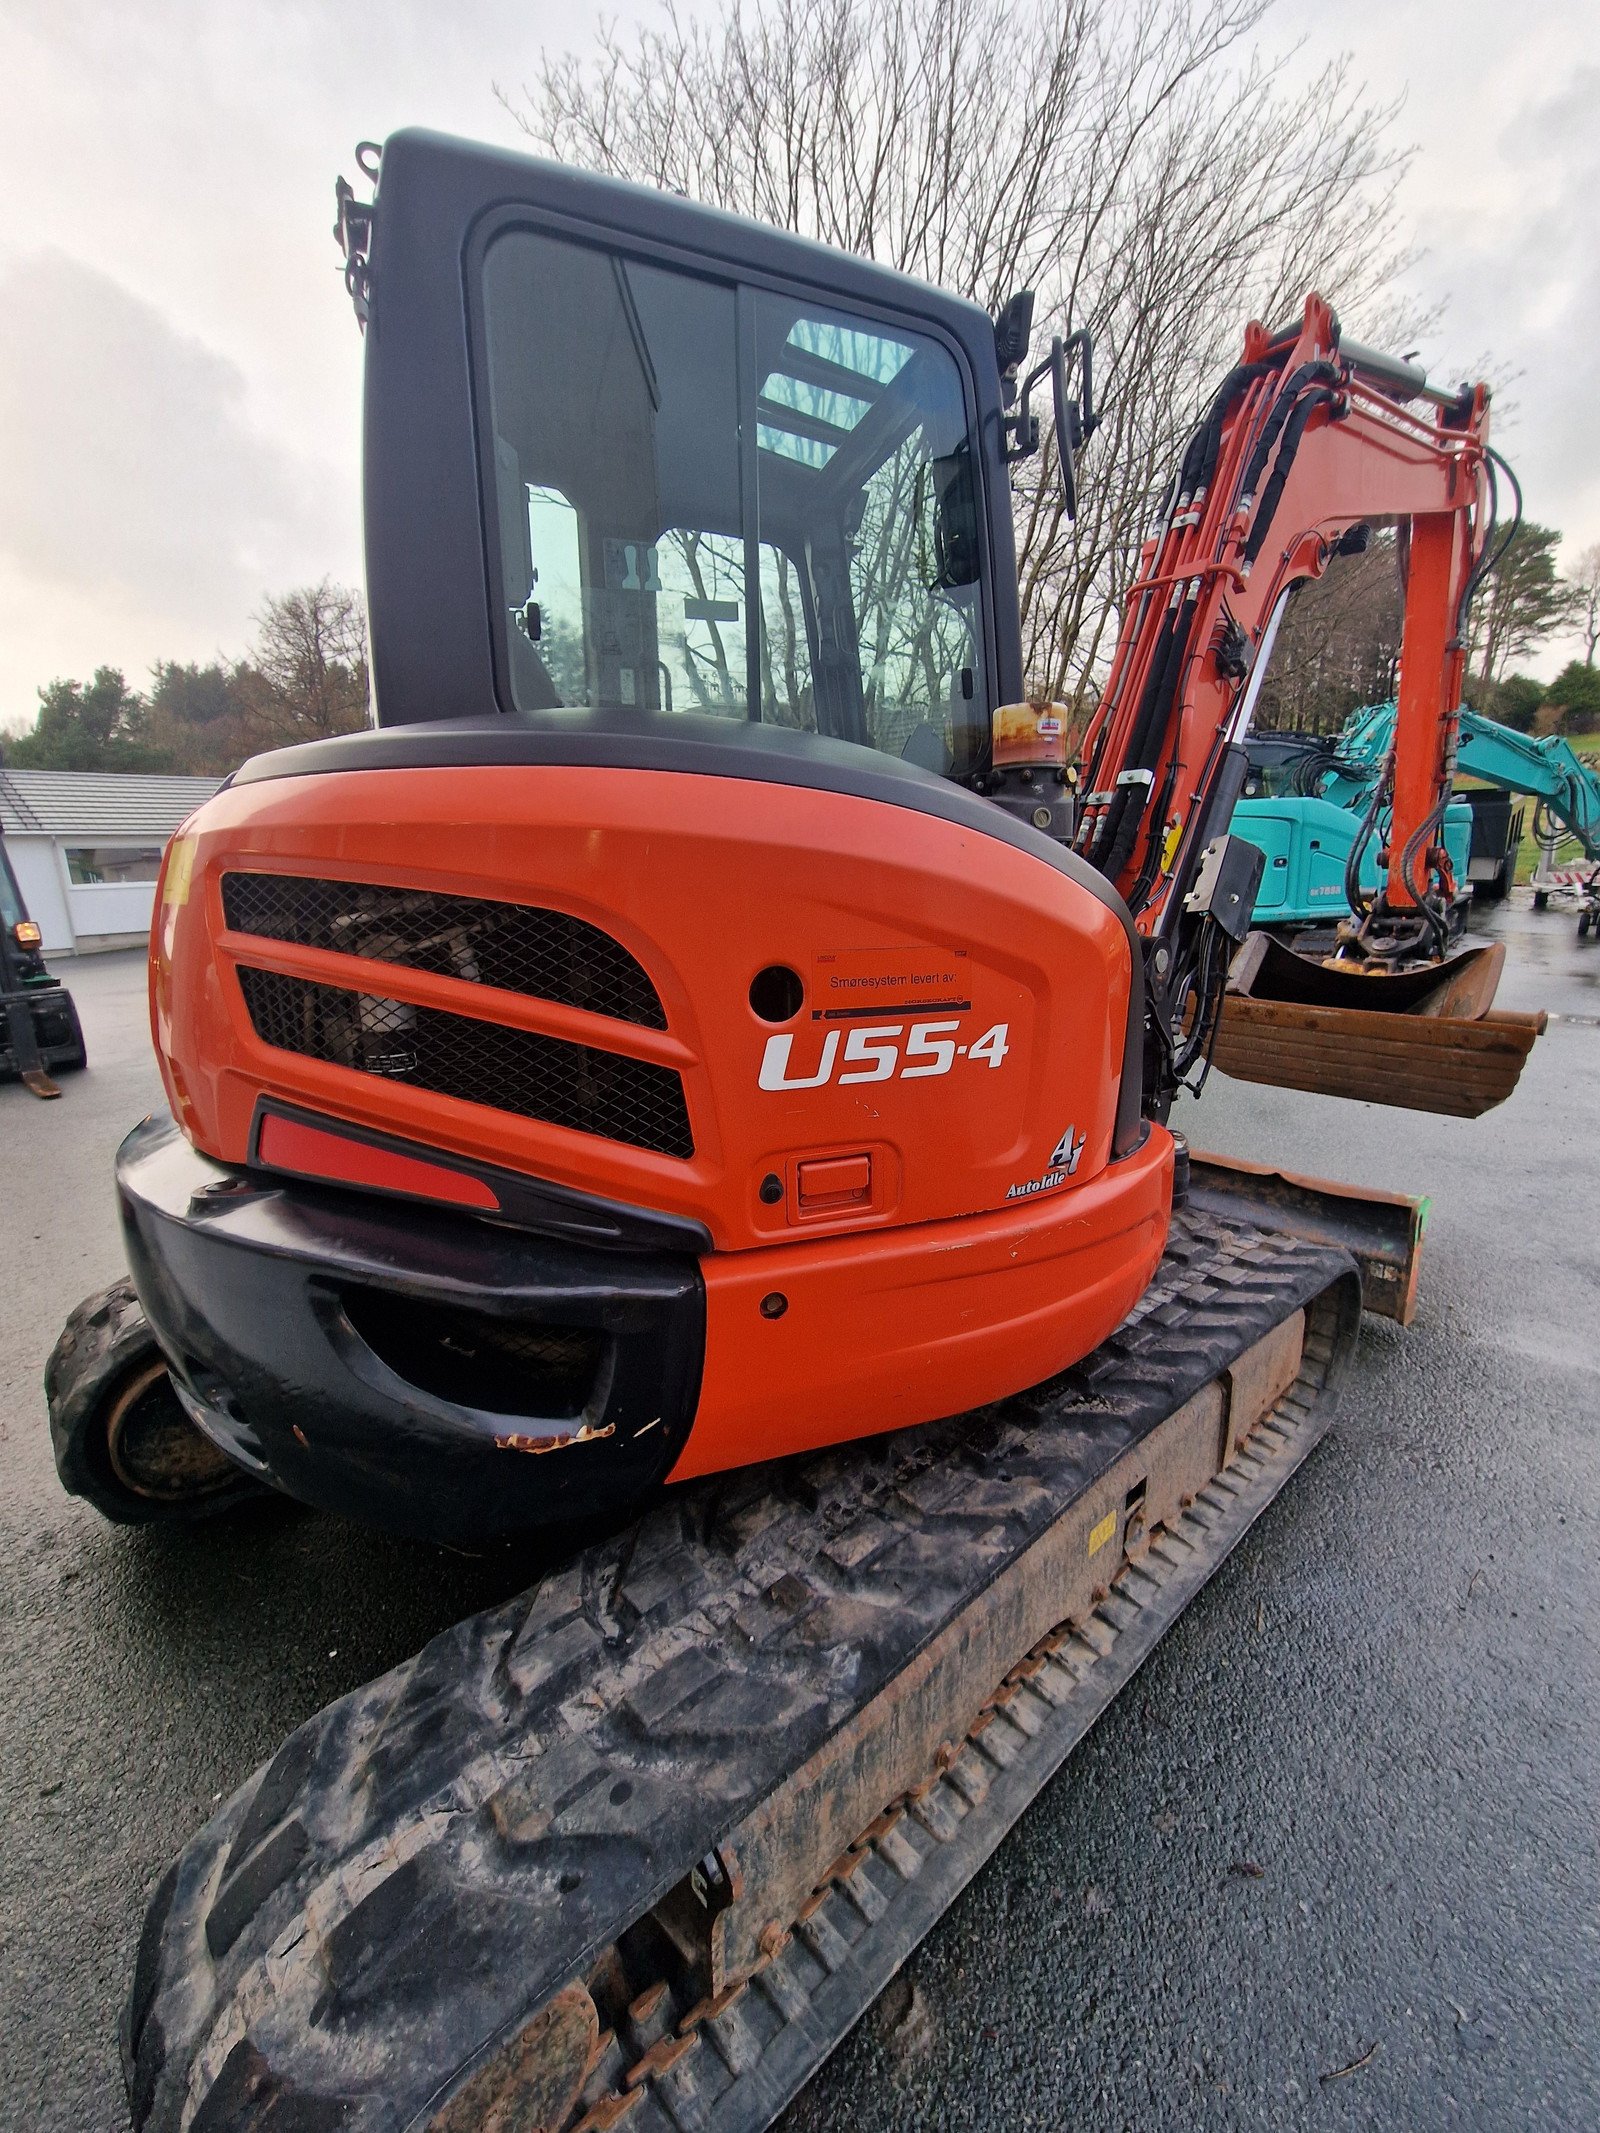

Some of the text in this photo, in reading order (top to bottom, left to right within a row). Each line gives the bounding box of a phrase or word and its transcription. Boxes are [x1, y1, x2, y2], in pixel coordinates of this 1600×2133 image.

[830, 974, 907, 989] Smøresystem
[911, 973, 939, 984] levert
[758, 1019, 1010, 1092] U55-4
[1005, 1171, 1067, 1200] AutoIdle
